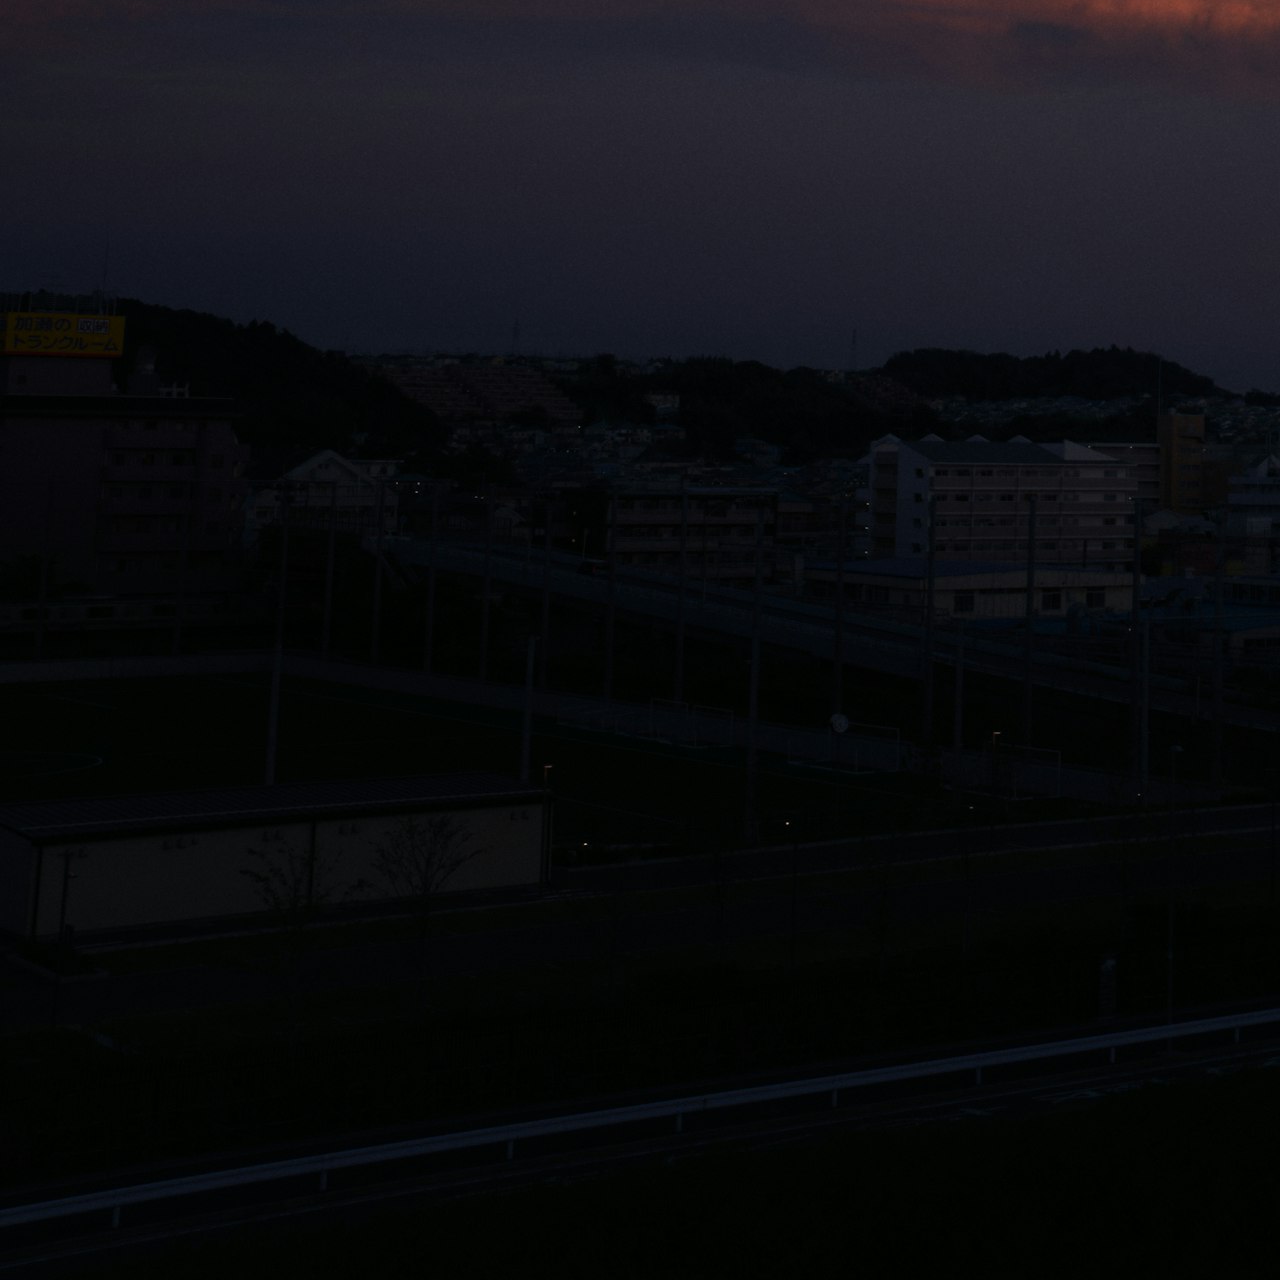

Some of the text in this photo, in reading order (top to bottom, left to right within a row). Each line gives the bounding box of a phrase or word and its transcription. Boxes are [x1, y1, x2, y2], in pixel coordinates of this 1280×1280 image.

[14, 334, 119, 351] トランクルーム
